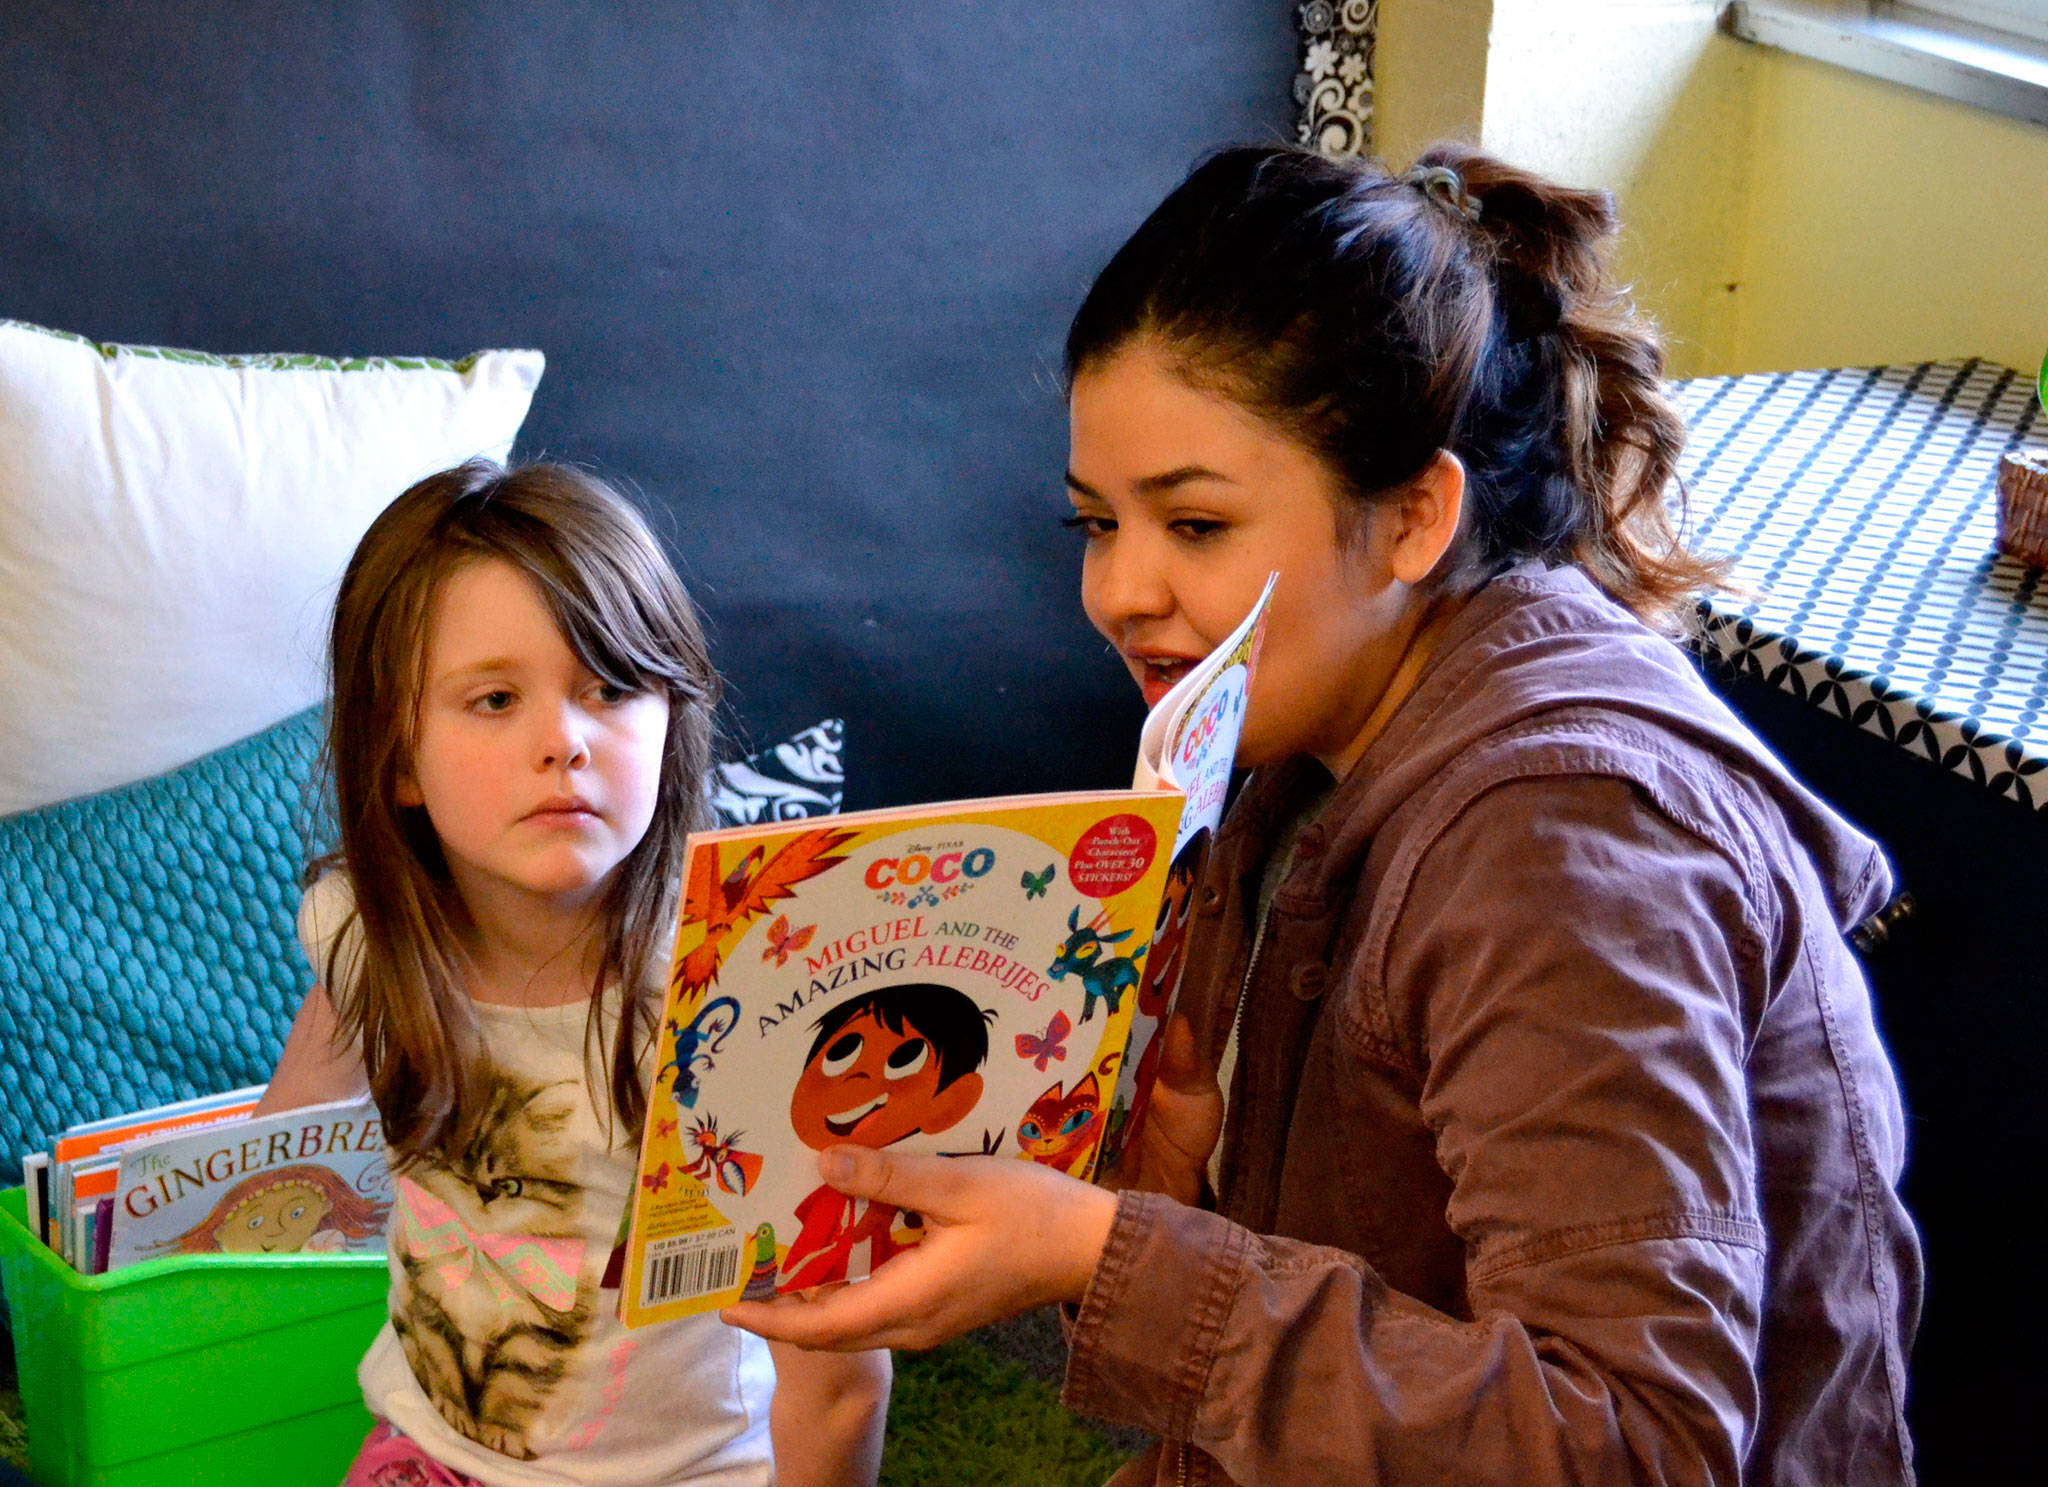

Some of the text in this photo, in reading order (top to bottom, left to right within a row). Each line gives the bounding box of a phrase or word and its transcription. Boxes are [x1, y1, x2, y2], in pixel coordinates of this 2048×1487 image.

[1183, 689, 1229, 763] COCO
[936, 840, 965, 850] PIXAR
[1074, 856, 1145, 870] Plus OVER 30
[864, 847, 996, 890] COCO
[1077, 872, 1134, 882] STICKERS!
[803, 915, 1020, 977] MIGUEL AND THE
[757, 944, 1051, 1039] AMAZING ALEBRIJES
[124, 1119, 384, 1218] GINGERBRE
[130, 1152, 171, 1179] The
